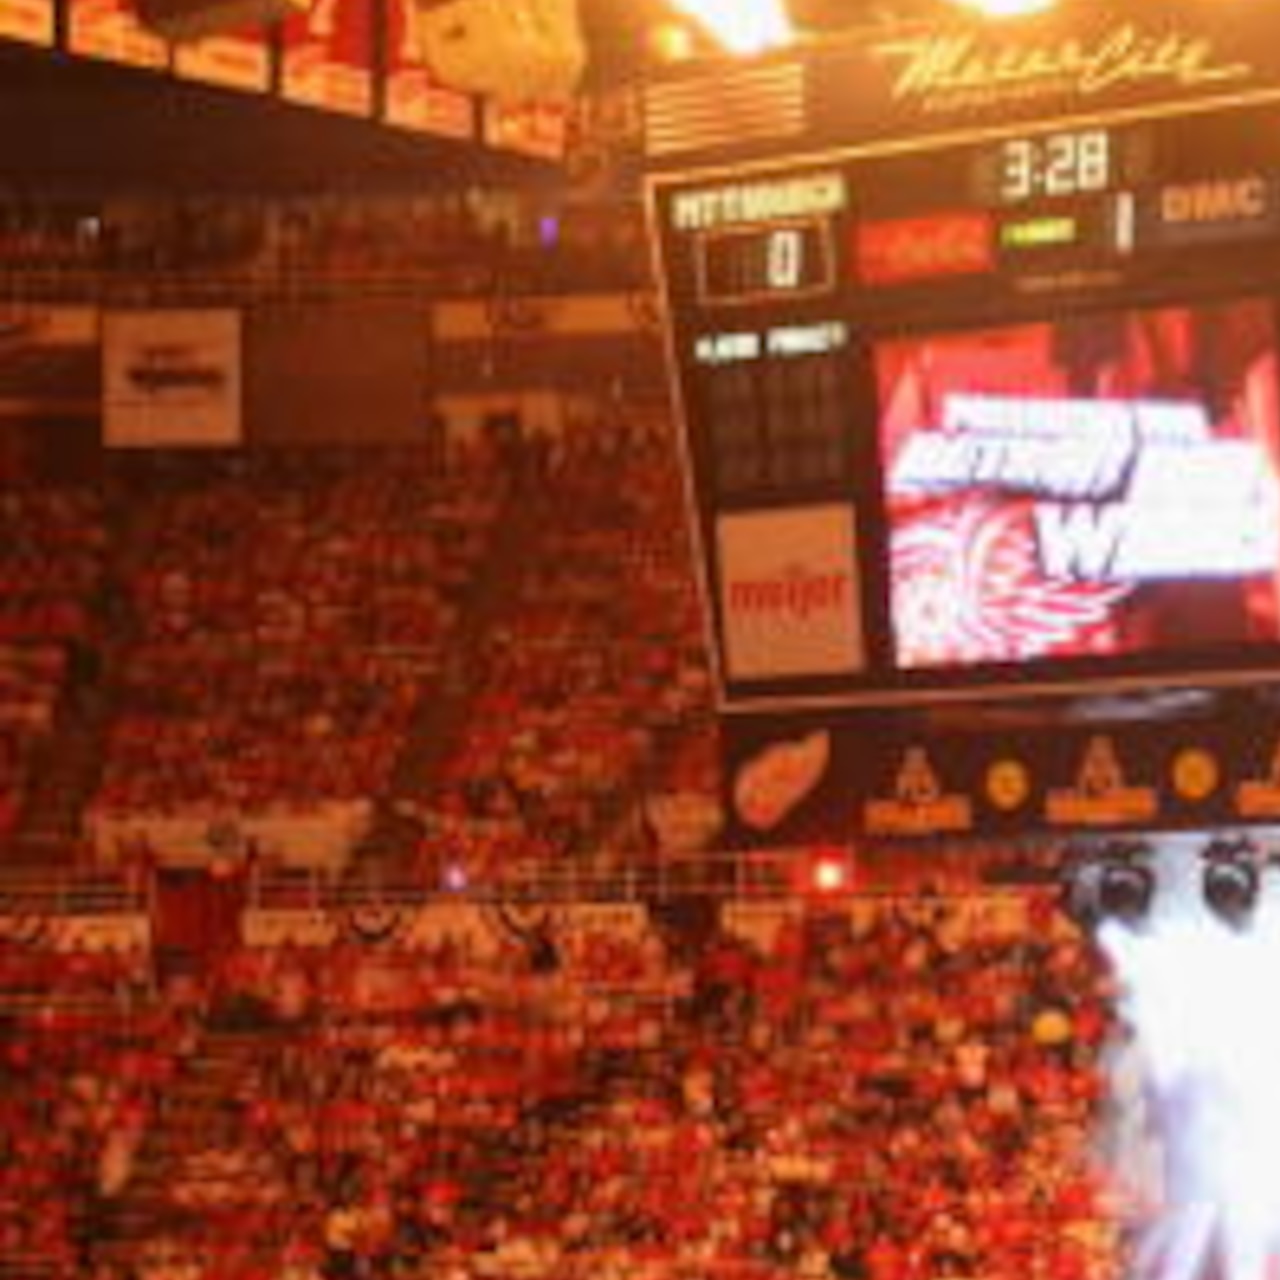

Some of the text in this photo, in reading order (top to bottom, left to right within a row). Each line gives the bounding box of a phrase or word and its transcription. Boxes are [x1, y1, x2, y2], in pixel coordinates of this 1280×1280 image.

[1002, 131, 1108, 200] 3:28
[1115, 190, 1135, 254] 1
[766, 229, 802, 288] 0
